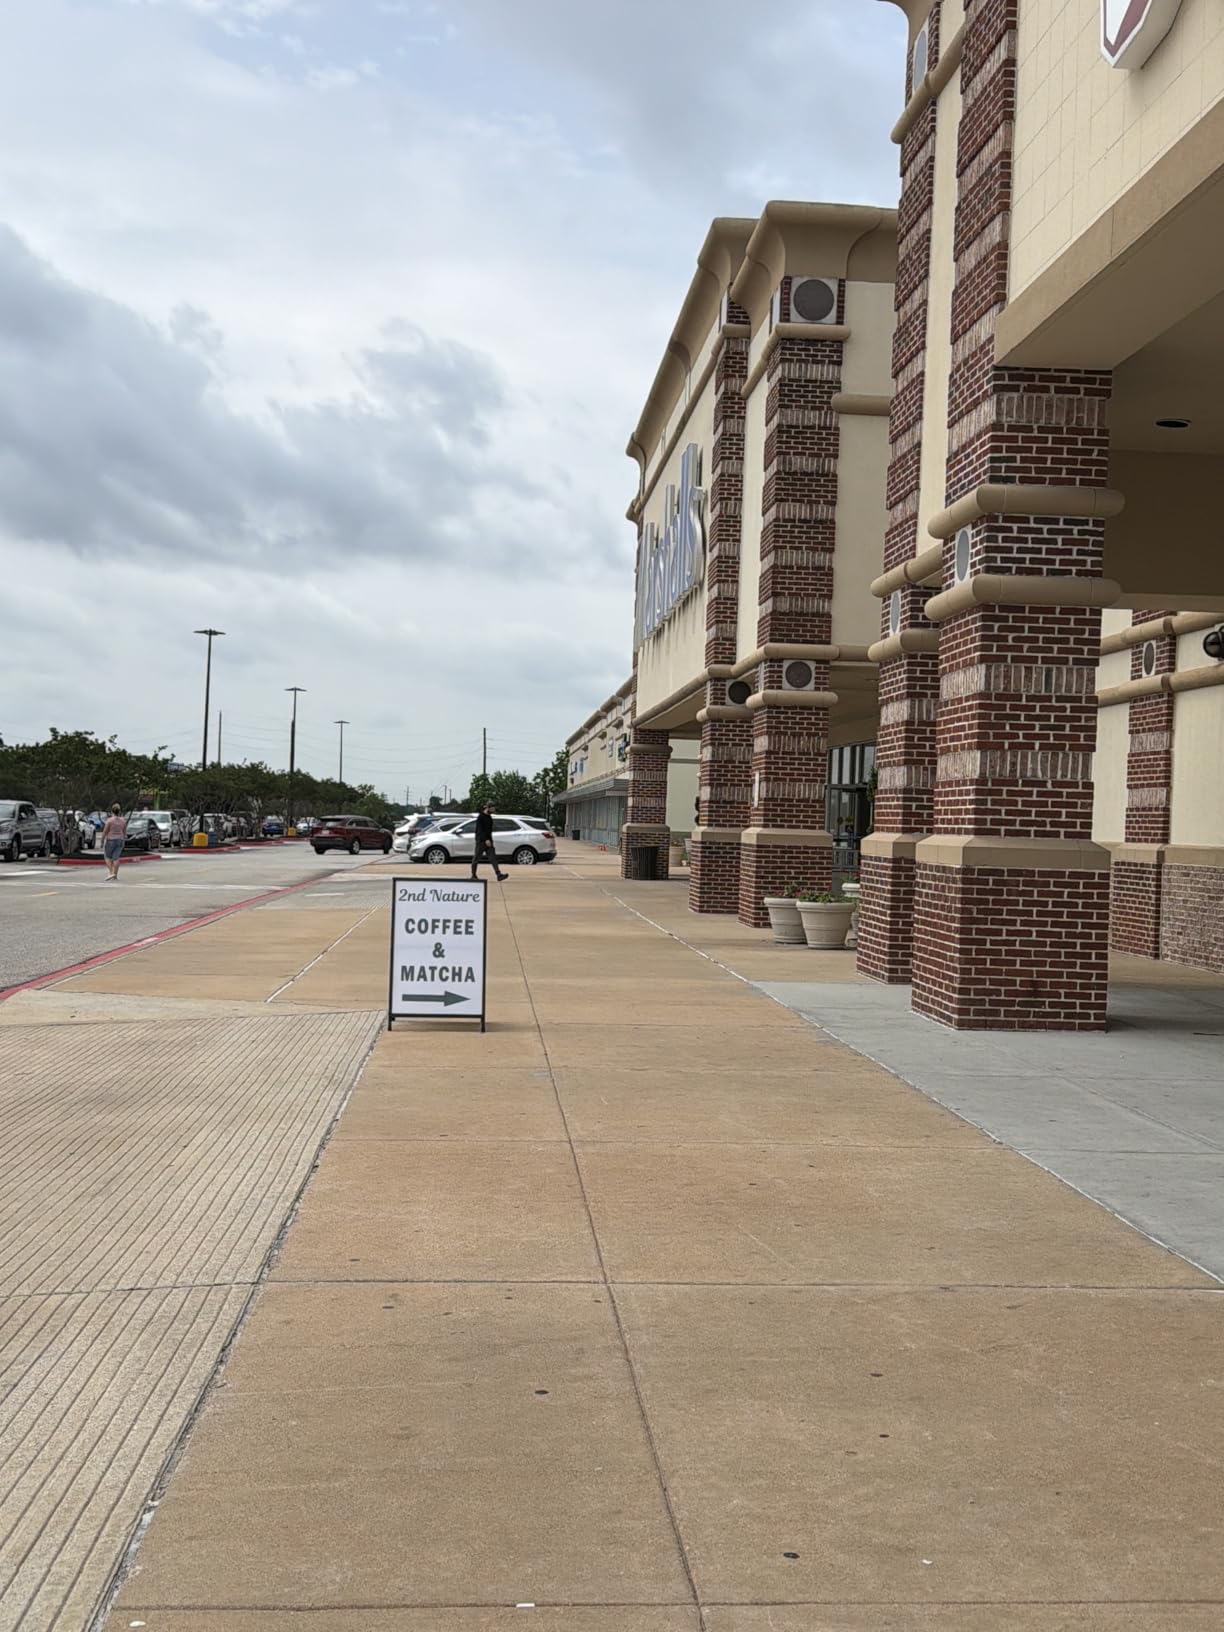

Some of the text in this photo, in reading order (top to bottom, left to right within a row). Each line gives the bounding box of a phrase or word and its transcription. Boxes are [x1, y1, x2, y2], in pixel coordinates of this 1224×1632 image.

[398, 887, 480, 902] 2nd Nature
[405, 918, 474, 935] COFFEE
[432, 942, 445, 958] &
[401, 965, 475, 982] MATCHA
